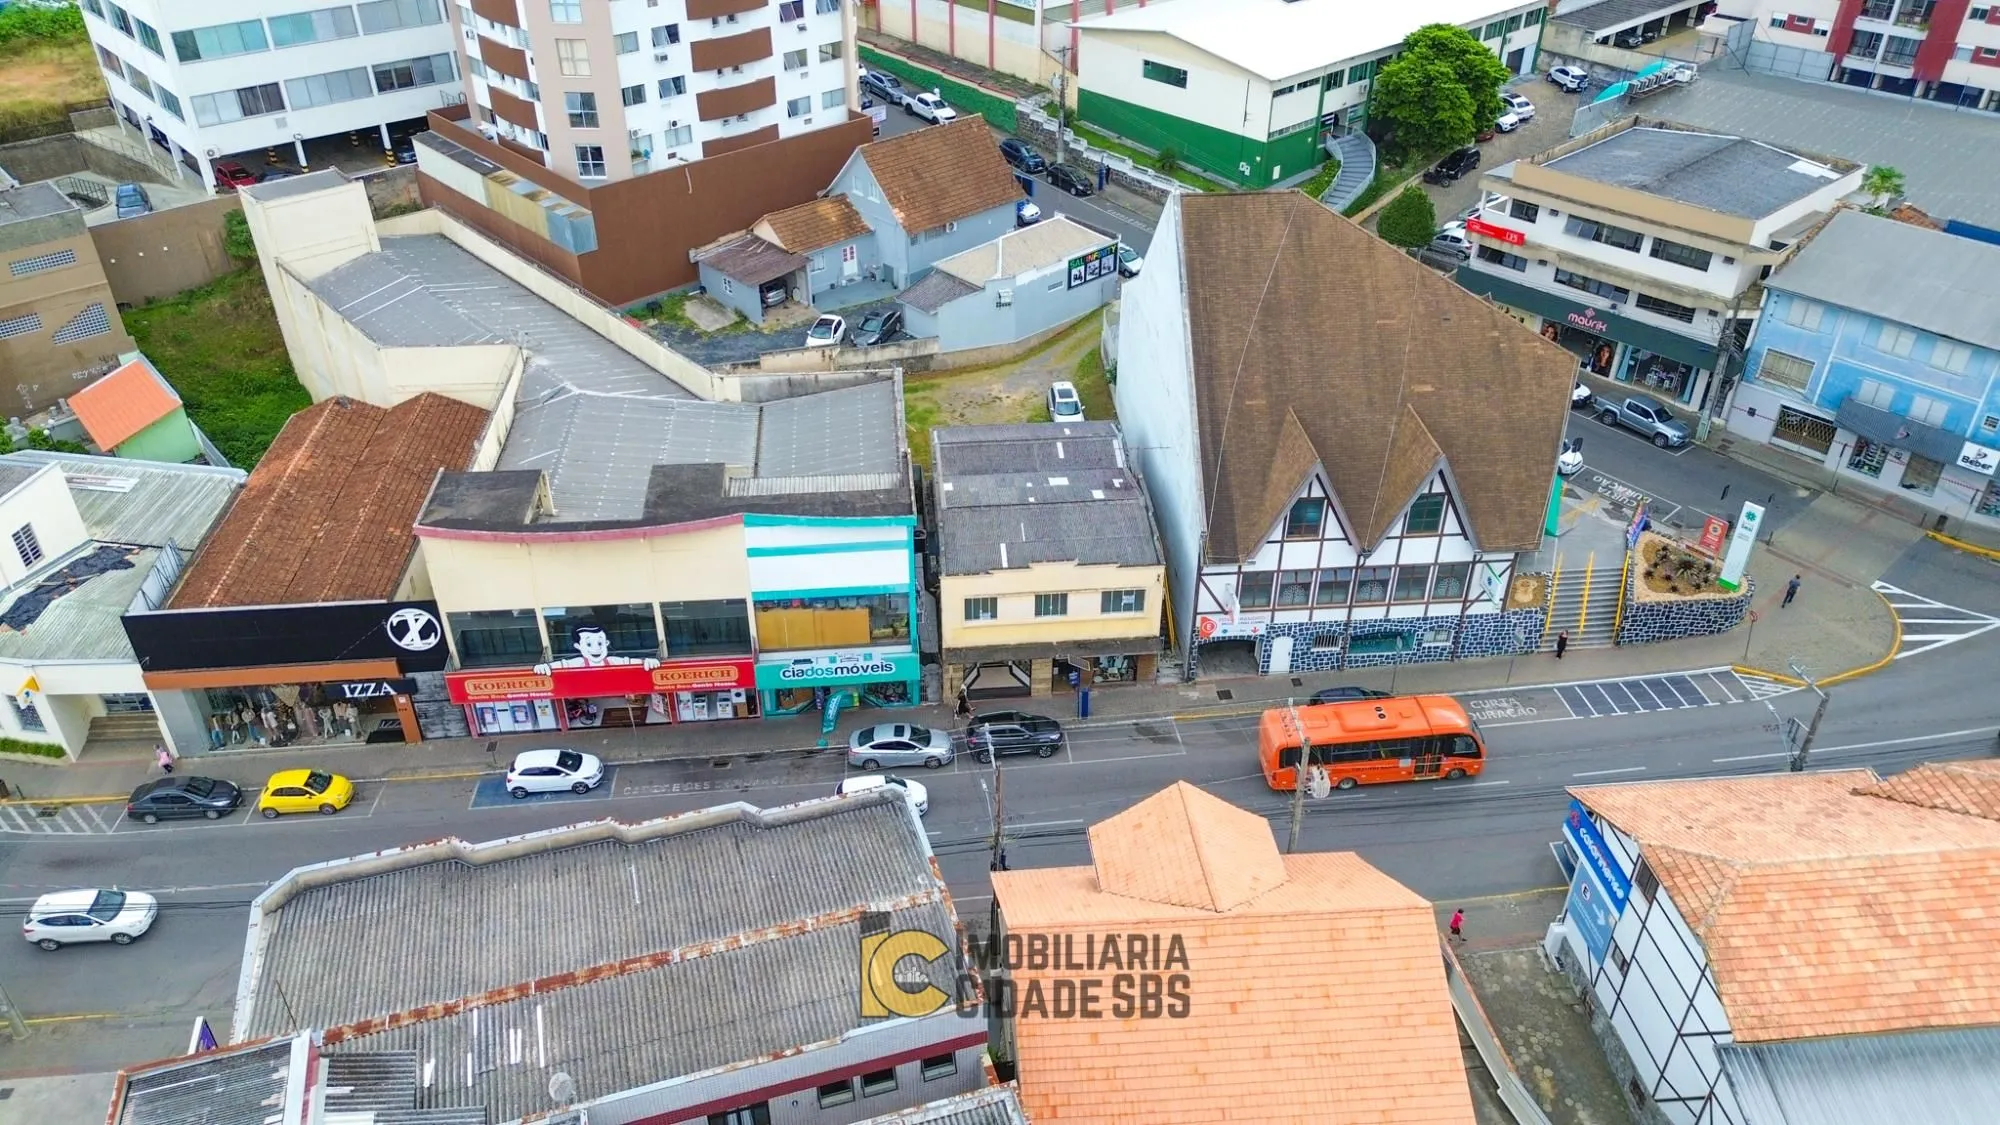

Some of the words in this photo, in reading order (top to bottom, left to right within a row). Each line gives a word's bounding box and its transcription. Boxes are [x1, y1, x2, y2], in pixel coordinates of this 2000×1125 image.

[1567, 312, 1608, 332] maurik
[659, 669, 731, 681] KOERICH
[781, 661, 894, 679] ciadosmóveis
[342, 682, 398, 698] IZZA
[472, 679, 547, 691] KOERICH
[1470, 697, 1520, 709] CURTA
